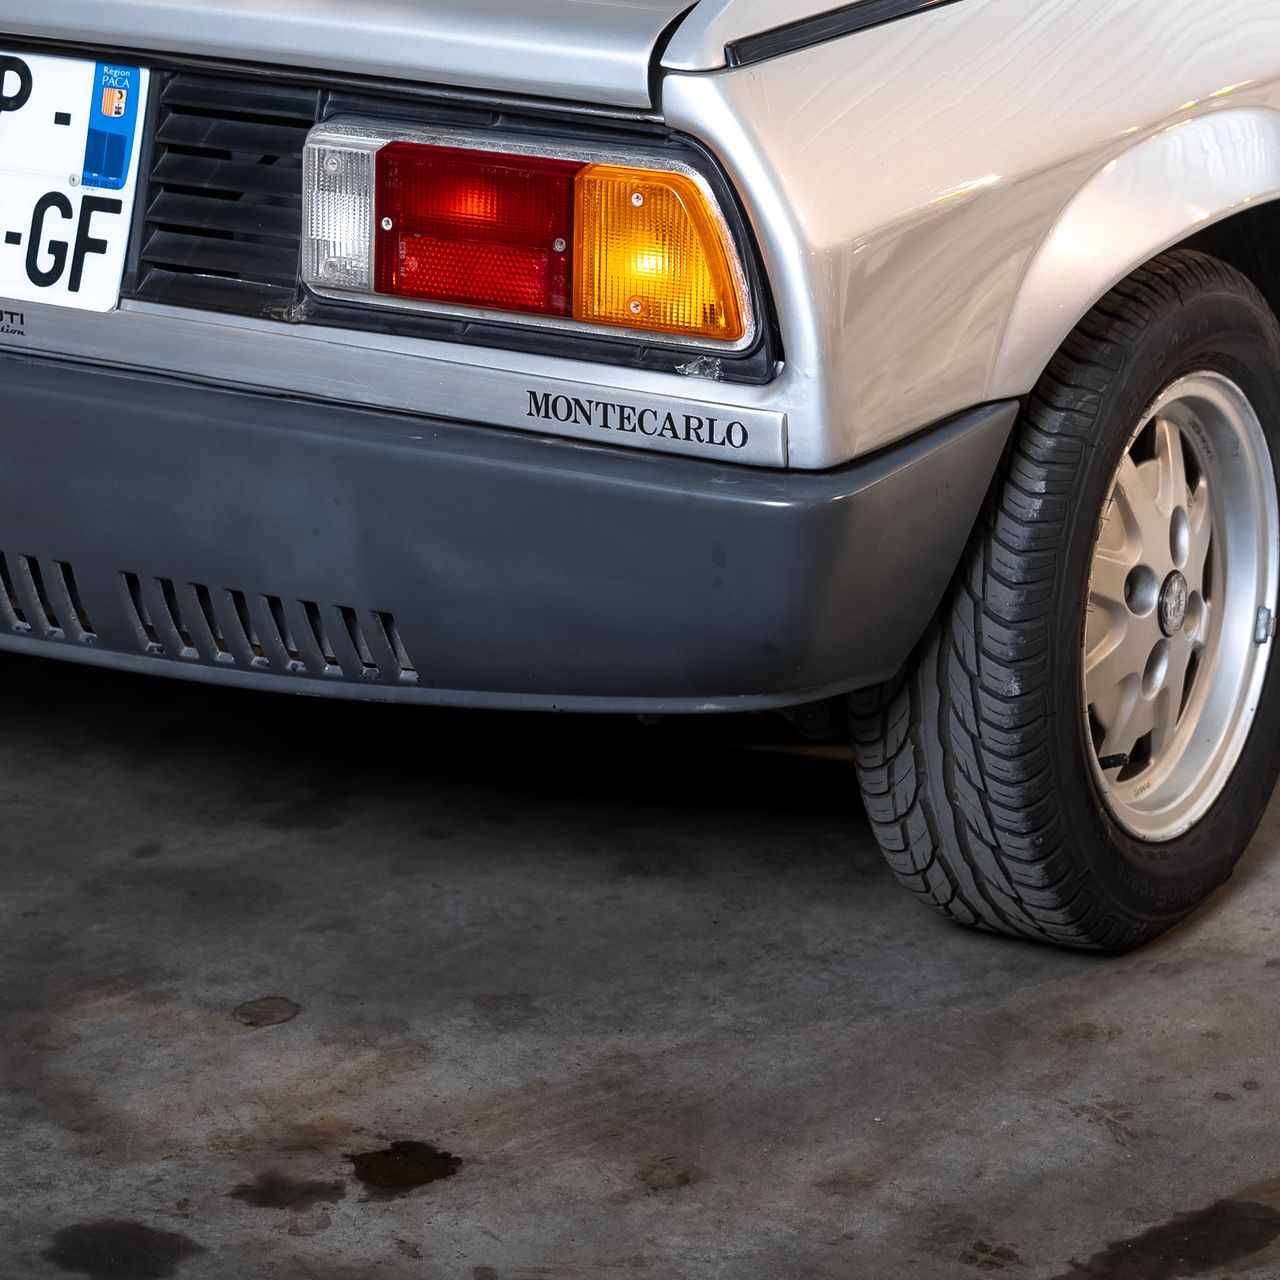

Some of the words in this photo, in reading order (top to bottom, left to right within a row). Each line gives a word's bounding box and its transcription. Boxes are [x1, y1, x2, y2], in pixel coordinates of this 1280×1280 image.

[103, 65, 131, 77] Région
[102, 75, 130, 89] PACA
[526, 390, 749, 449] MONTECARLO
